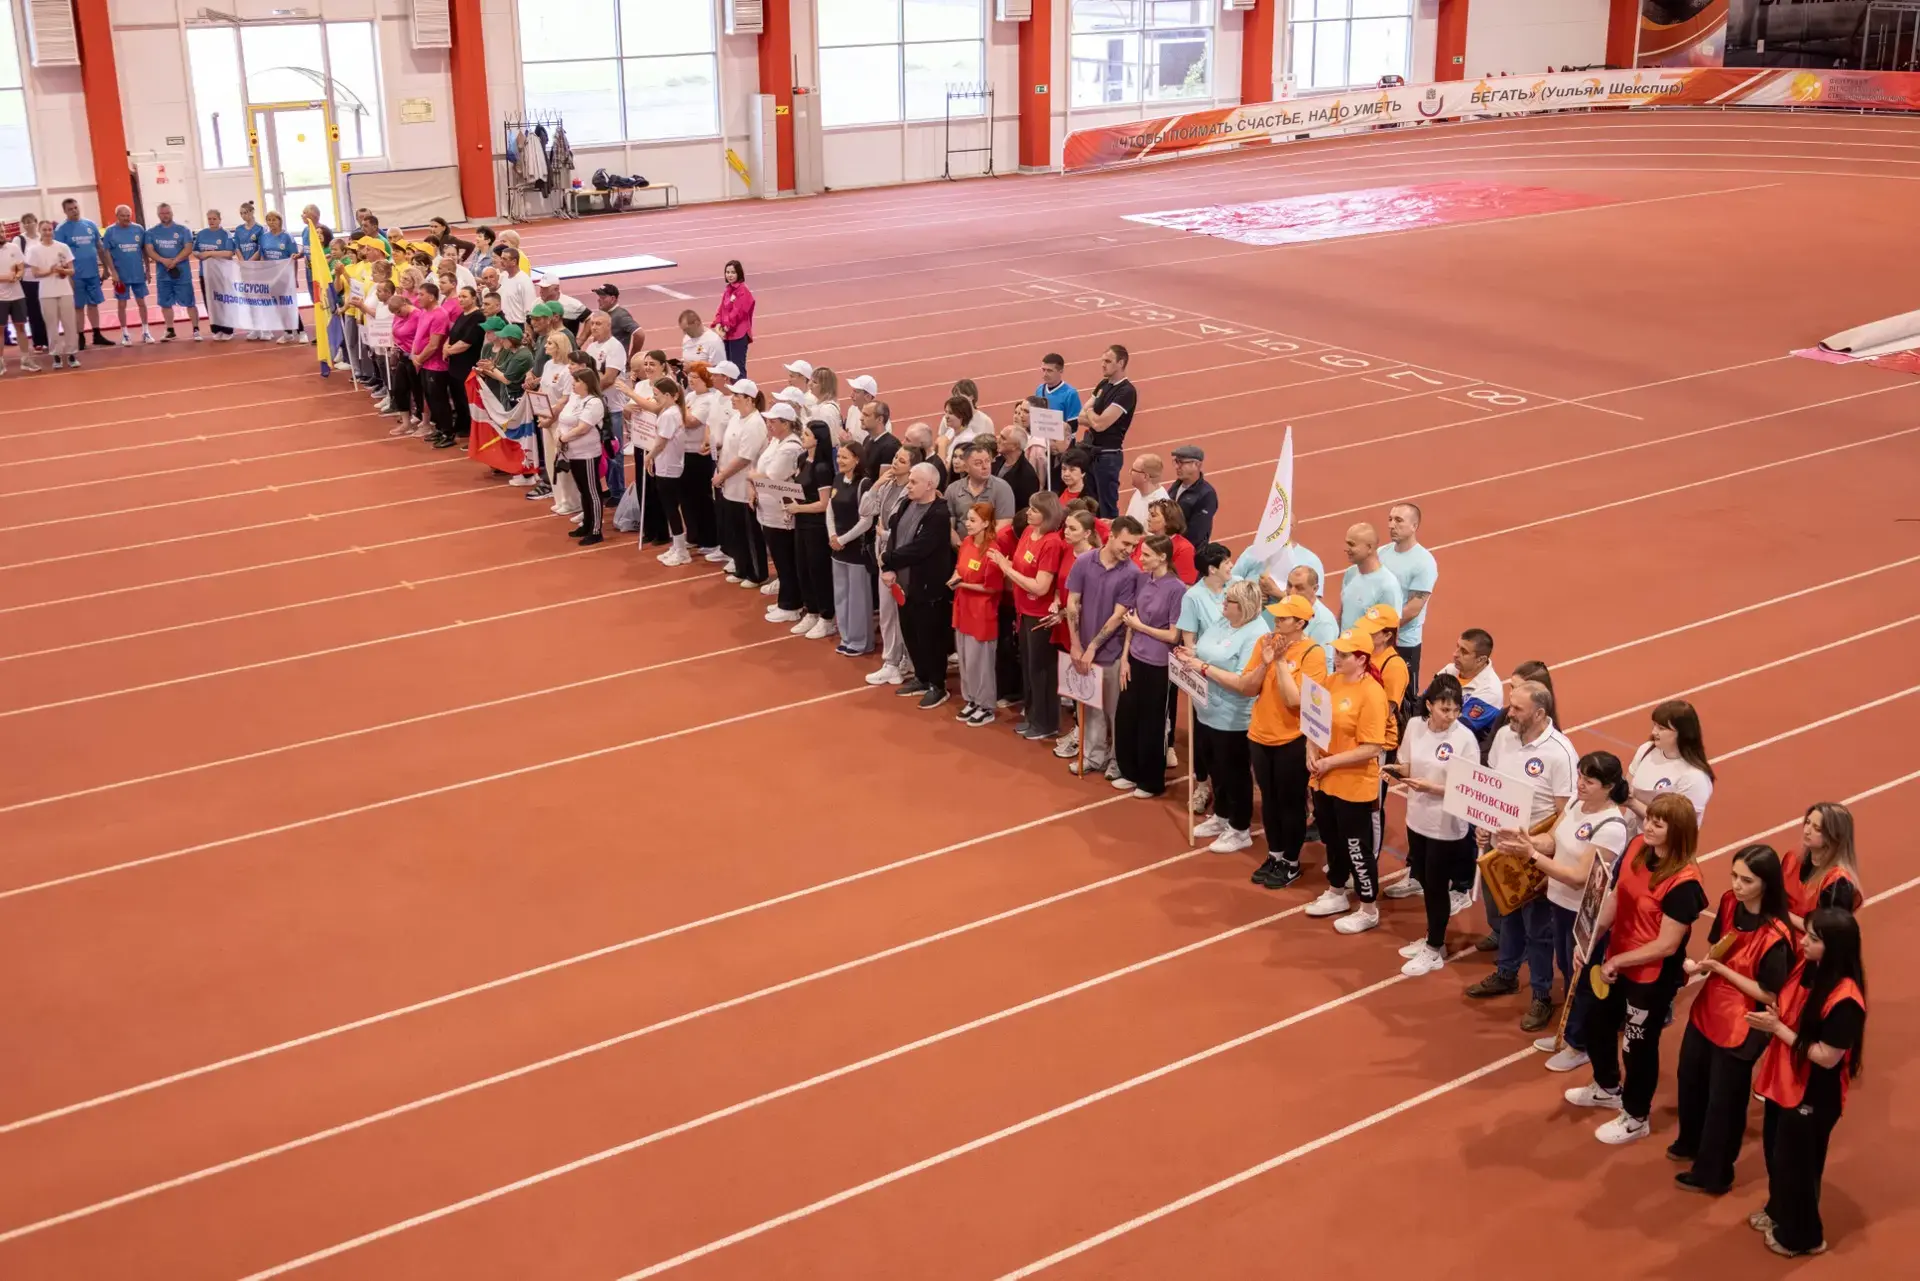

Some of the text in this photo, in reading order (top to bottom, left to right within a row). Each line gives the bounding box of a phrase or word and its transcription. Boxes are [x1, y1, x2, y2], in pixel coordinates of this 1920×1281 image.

[1170, 122, 1233, 141] ПОЙМАТЬ
[1237, 112, 1304, 131] СЧАСТЬЕ,
[1308, 106, 1349, 122] НАДО
[1353, 100, 1402, 116] УМЕТЬ
[1470, 89, 1536, 104] БЕГАТЬ»
[1541, 84, 1604, 100] (Уильям
[1608, 81, 1684, 96] Шекспир)
[1027, 284, 1062, 293] 1
[1074, 296, 1122, 308] 2
[1129, 310, 1176, 321] 3
[1199, 323, 1242, 335] 4
[1248, 338, 1300, 351] 5
[1319, 354, 1370, 368] 6
[1386, 371, 1444, 385] 7
[1466, 389, 1528, 406] 8
[1472, 770, 1502, 789] ГБУСО
[1455, 783, 1520, 818] «ТРУНОВСКИЙ
[1347, 838, 1374, 898] DREAMFIT
